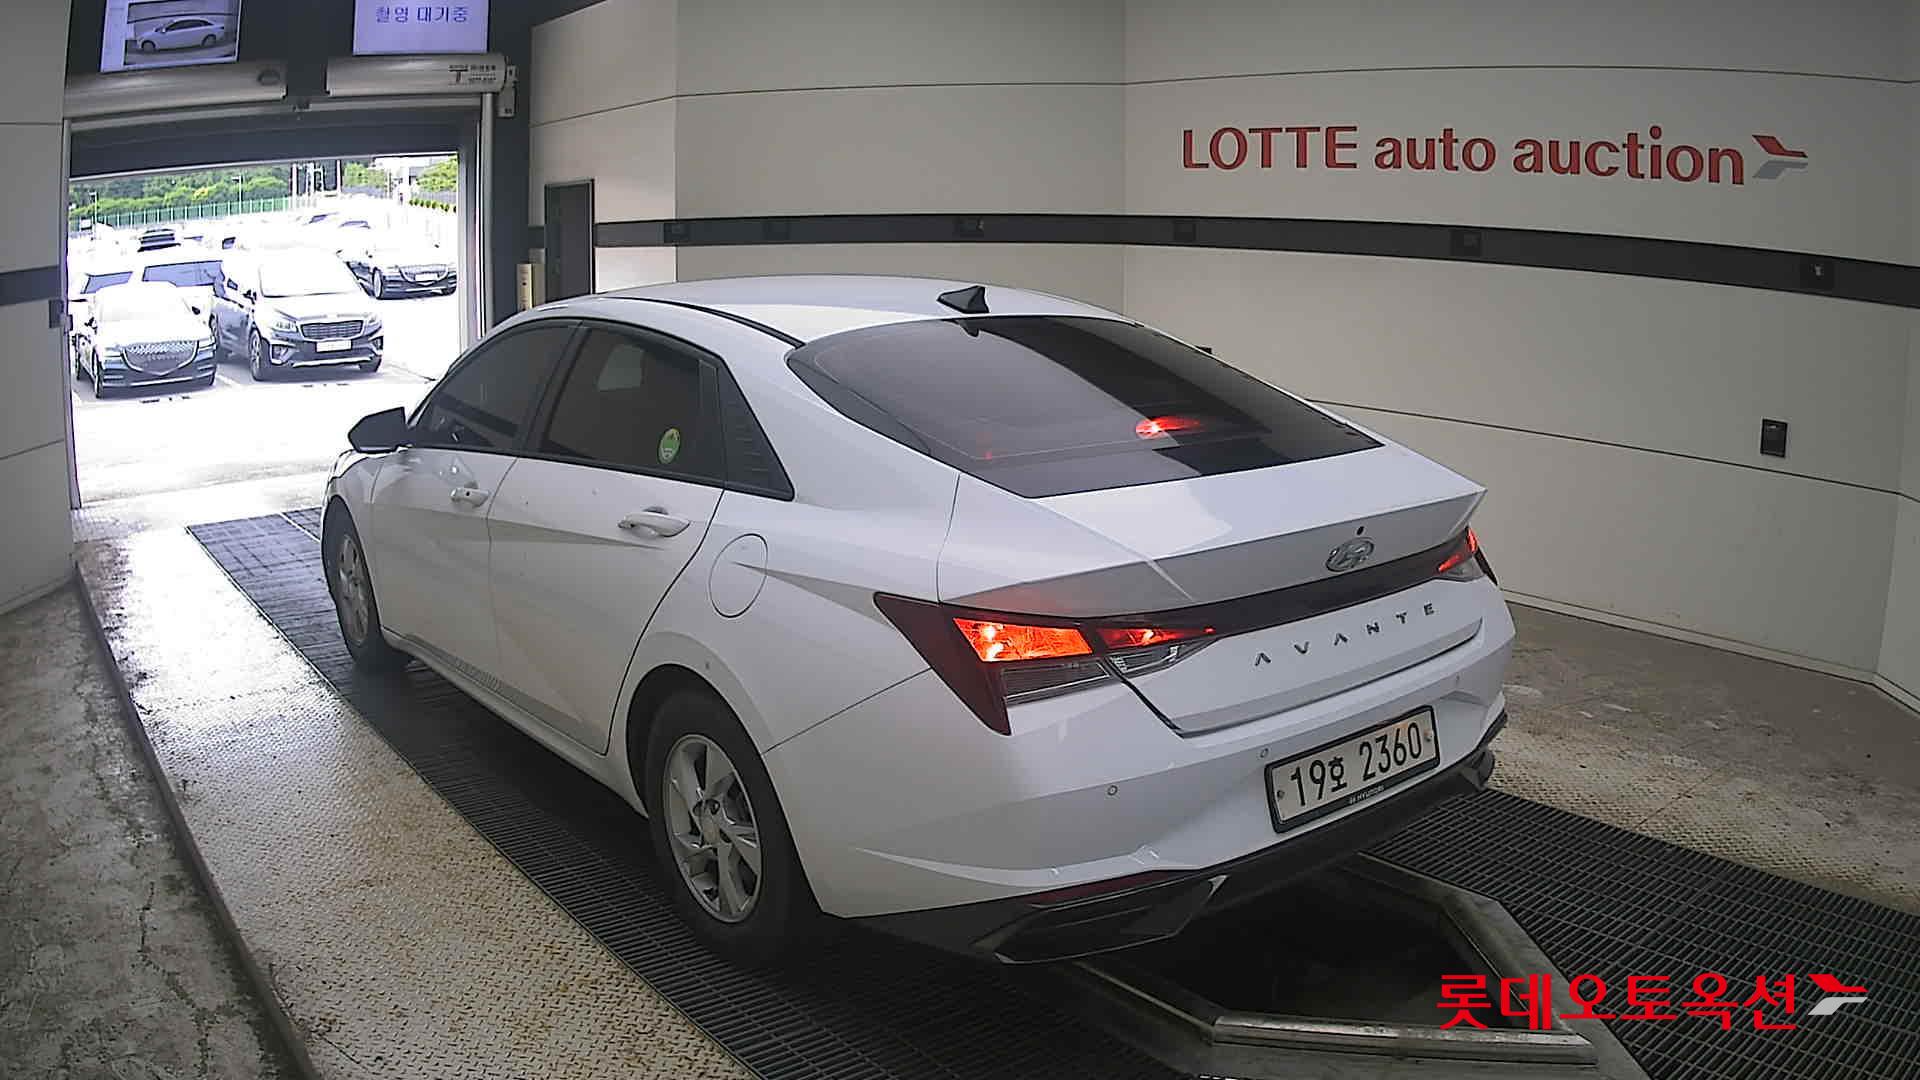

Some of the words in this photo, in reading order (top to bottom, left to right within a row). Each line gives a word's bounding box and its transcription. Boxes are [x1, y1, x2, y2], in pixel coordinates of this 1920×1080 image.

[417, 6, 468, 22] 대기중
[1183, 126, 1358, 169] LOTTE
[1374, 128, 1496, 172] auto
[1513, 126, 1744, 185] auction
[1254, 603, 1435, 666] AVANTE
[1290, 756, 1347, 806] 19호
[1359, 721, 1423, 782] 2360
